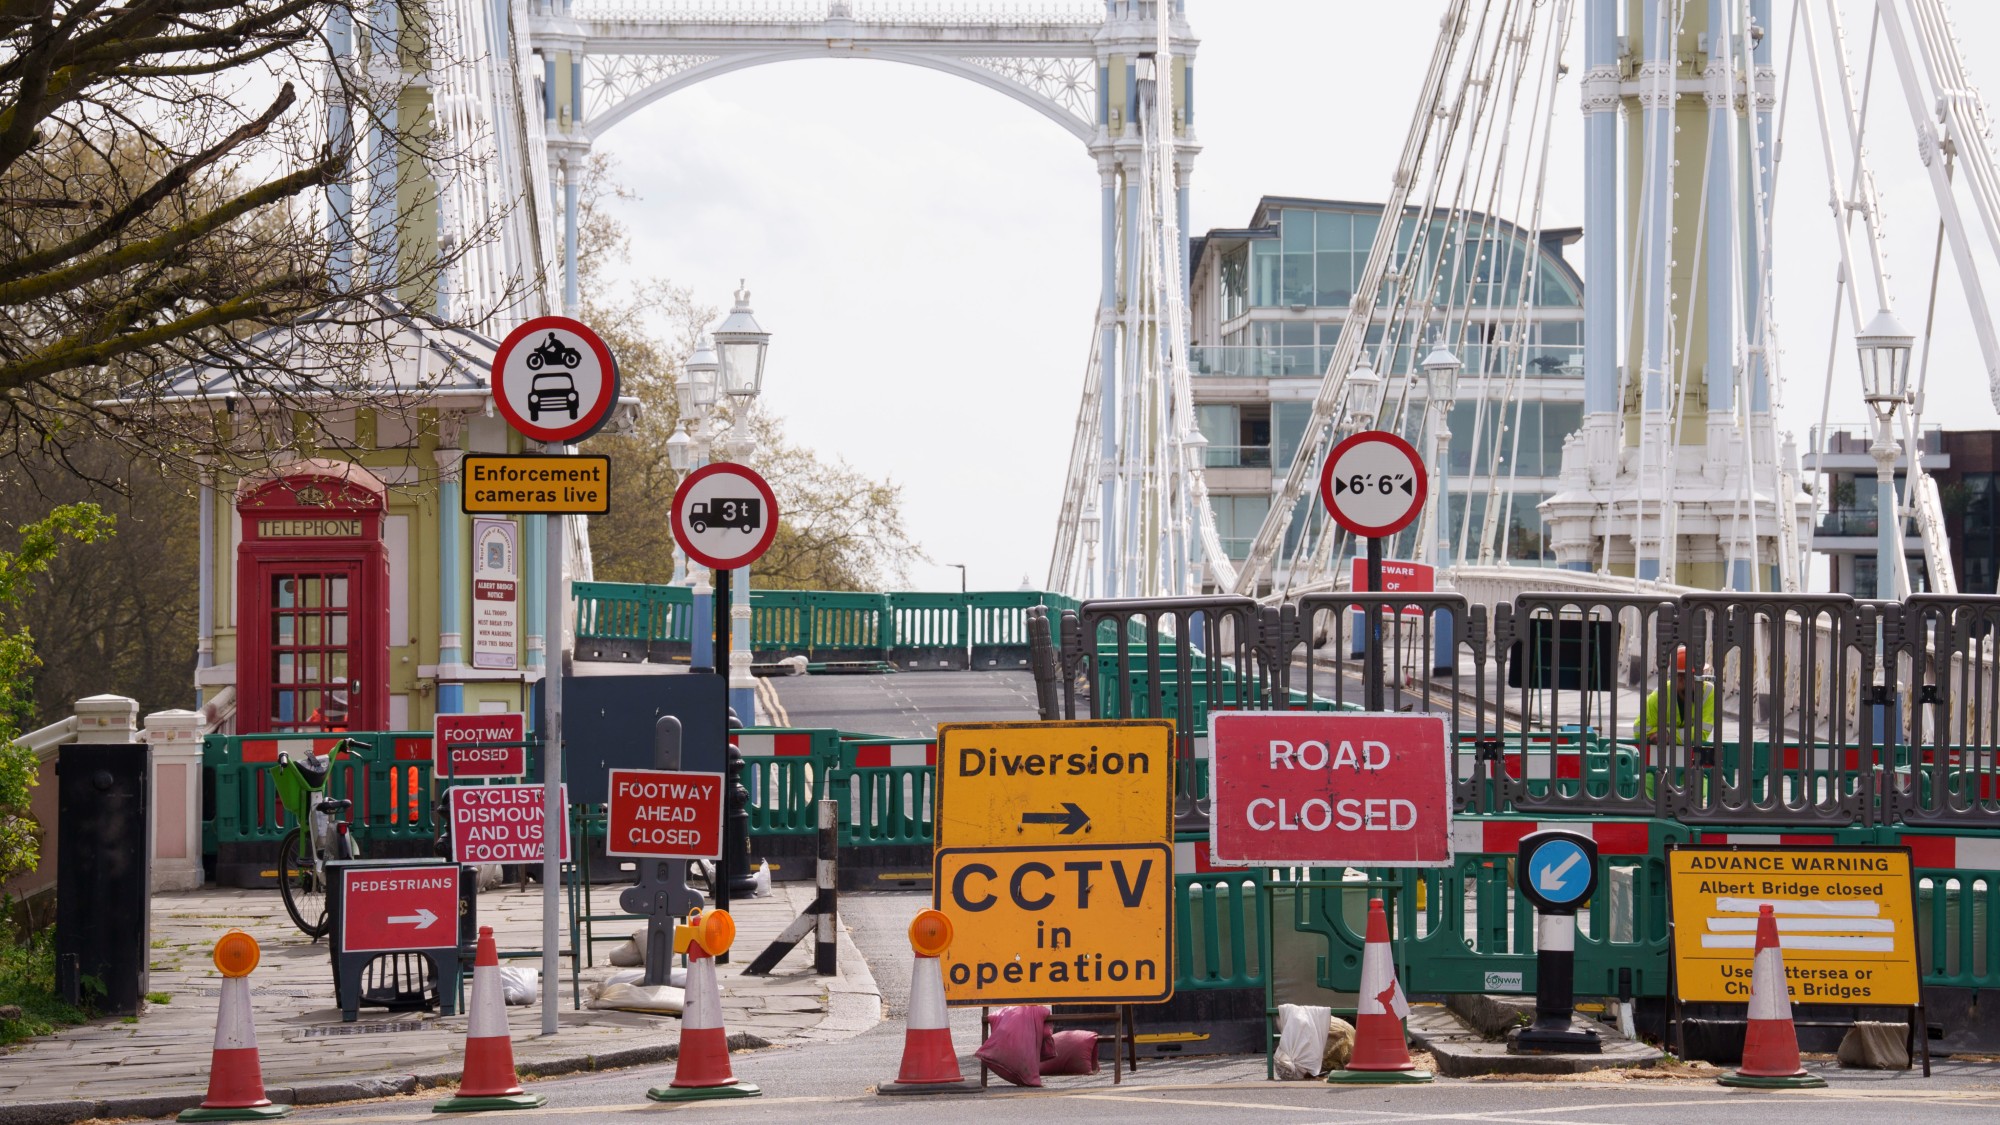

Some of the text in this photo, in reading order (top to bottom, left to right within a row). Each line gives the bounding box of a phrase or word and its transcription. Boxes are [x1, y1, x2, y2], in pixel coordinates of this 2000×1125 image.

[475, 465, 600, 481] Enforcement
[475, 487, 598, 502] cameras live
[260, 520, 360, 536] TELEPHONE
[1382, 566, 1414, 576] EWARE
[1387, 582, 1400, 591] OF
[445, 728, 514, 741] FOOTWAY
[451, 749, 509, 762] CLOSED
[959, 745, 1149, 777] Diversion
[1269, 740, 1391, 770] ROAD
[462, 788, 544, 805] CYCLIST
[619, 782, 713, 800] FOOTWAY
[458, 806, 544, 823] DISMOUN
[635, 805, 697, 822] AHEAD
[1246, 798, 1418, 831] CLOSED
[468, 824, 544, 841] AND US
[628, 828, 701, 845] CLOSED
[465, 843, 544, 859] FOOTWA
[1691, 856, 1889, 871] ADVANCE WARNING
[352, 878, 453, 892] PEDESTRIANS
[952, 859, 1153, 913] CCTV
[1700, 881, 1883, 898] Albert Bridge closed
[1037, 920, 1072, 949] in
[949, 953, 1156, 990] operation
[1485, 974, 1521, 985] CONWAY
[1721, 965, 1873, 980] Use ttersea or
[1803, 982, 1872, 999] Bridges
